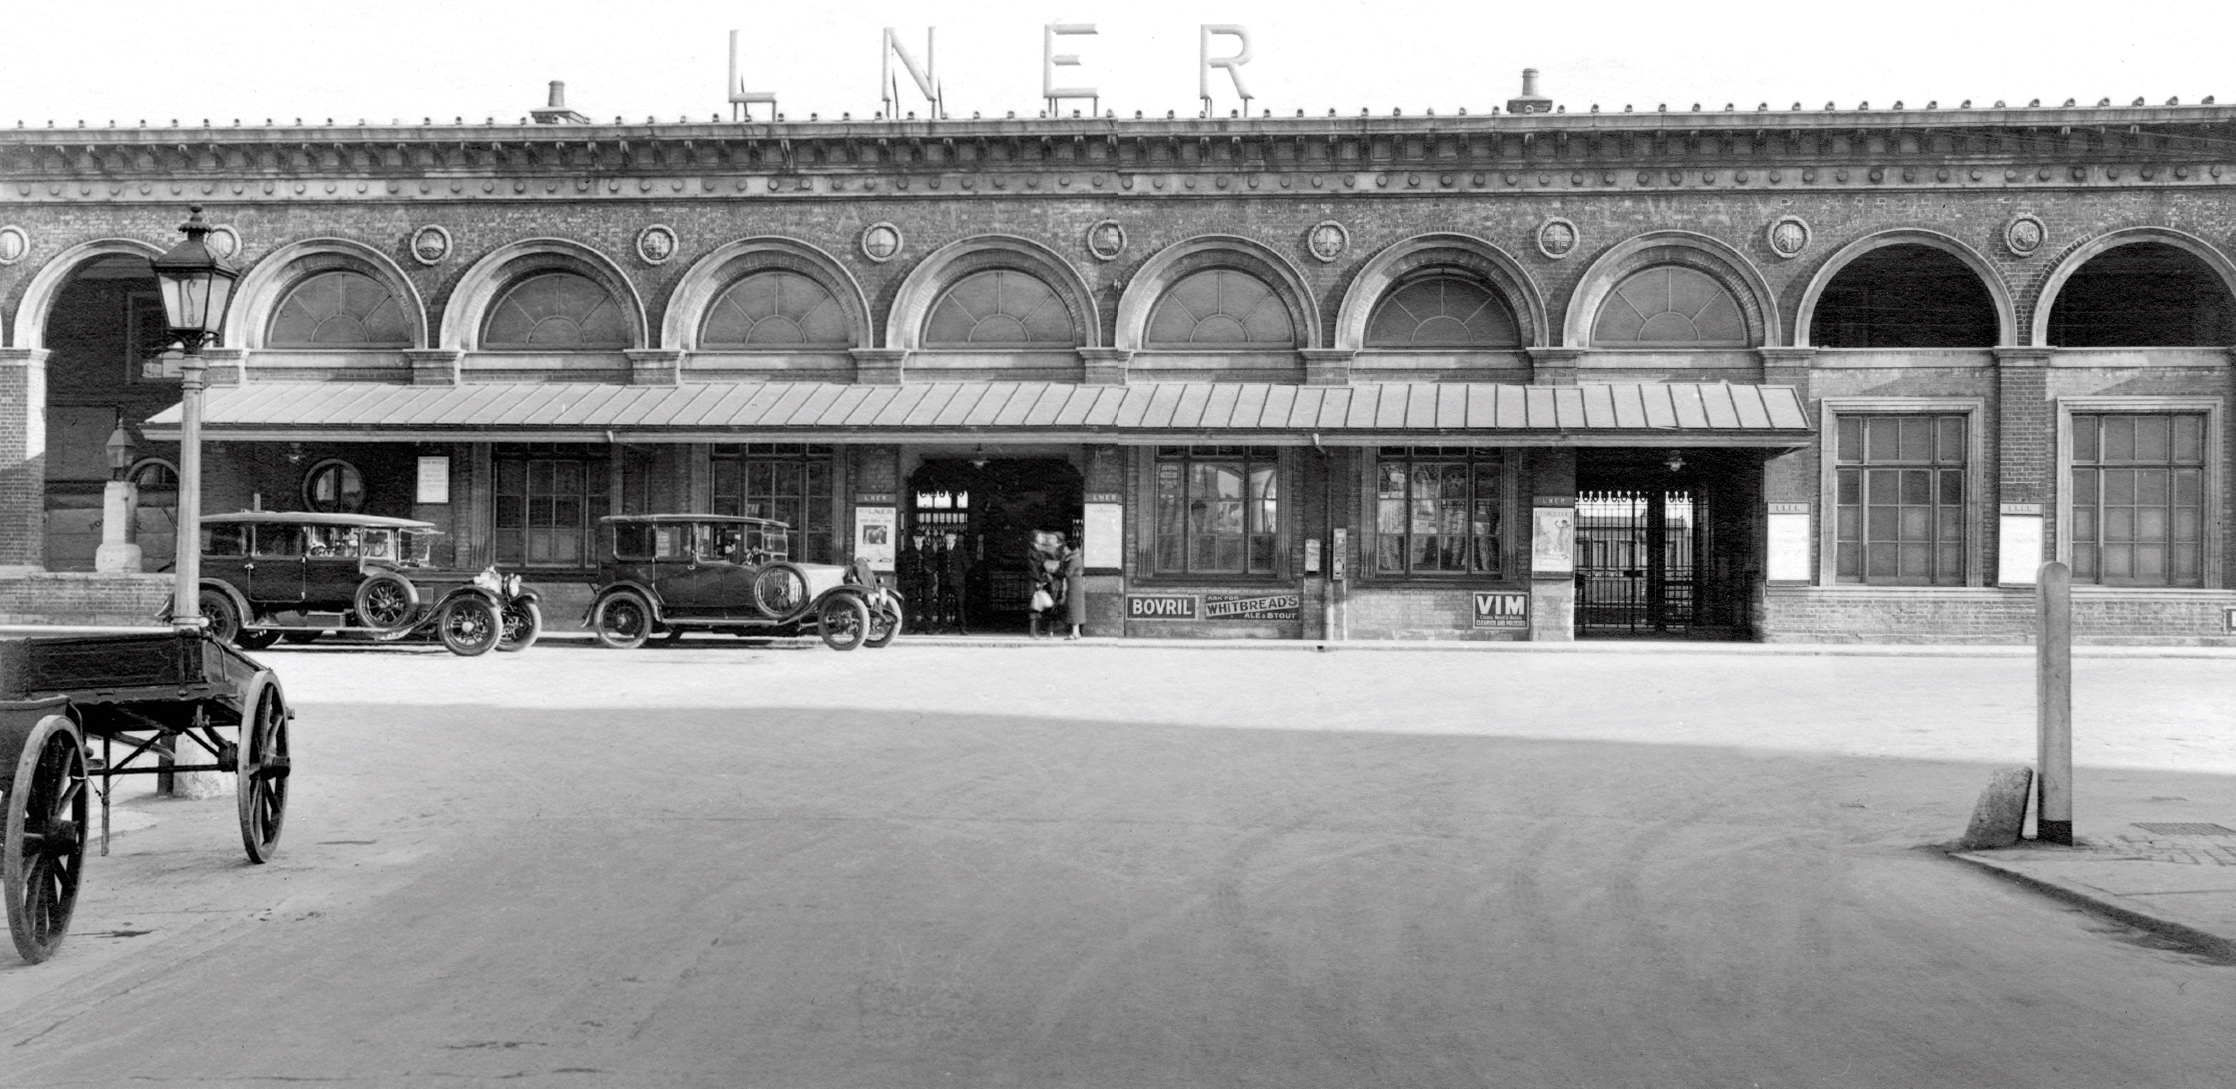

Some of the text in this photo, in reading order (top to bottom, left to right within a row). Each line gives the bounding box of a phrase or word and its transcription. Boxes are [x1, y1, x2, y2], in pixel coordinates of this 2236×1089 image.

[1132, 599, 1192, 615] BOVRIL
[1207, 596, 1298, 615] WHITBREAD'S
[1476, 596, 1525, 615] VIM
